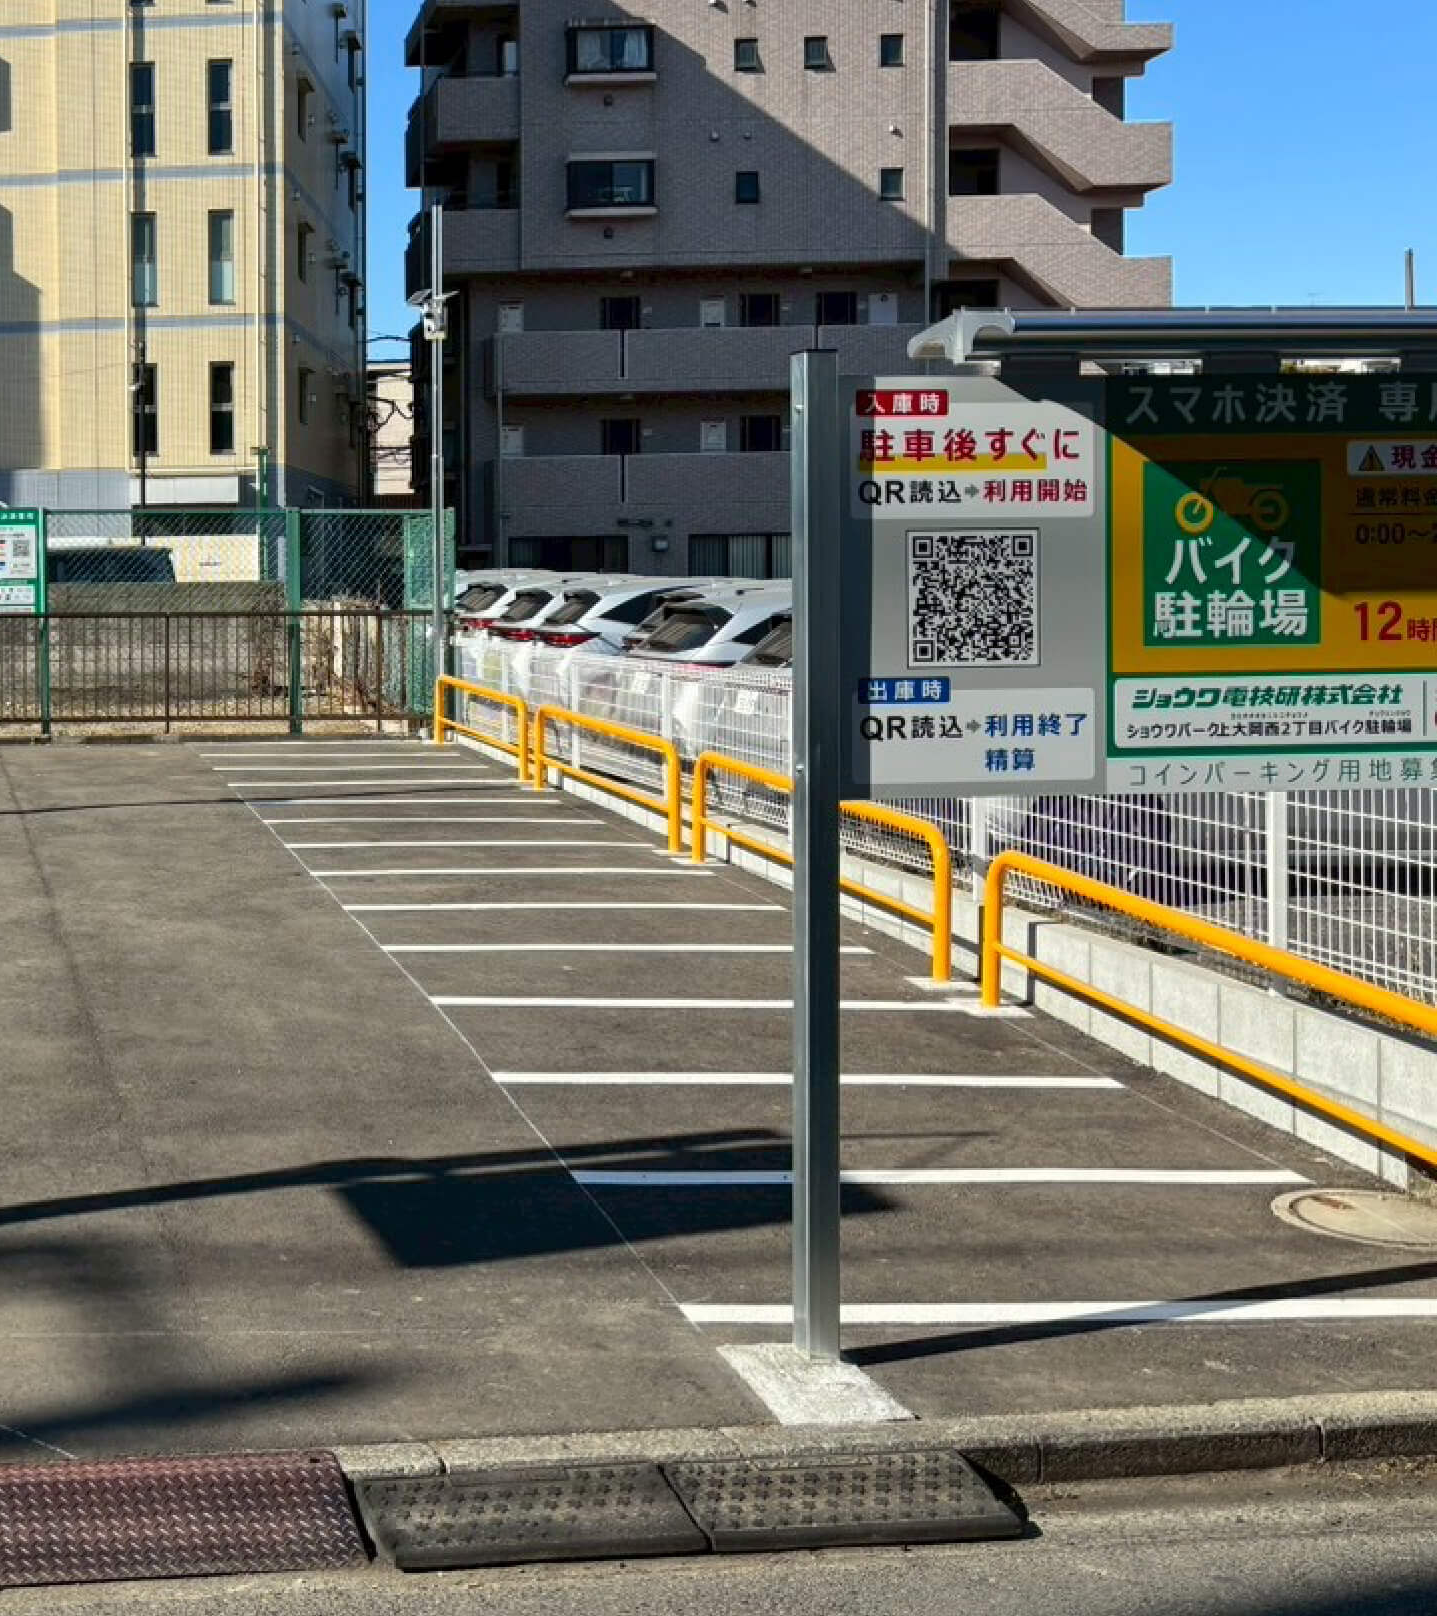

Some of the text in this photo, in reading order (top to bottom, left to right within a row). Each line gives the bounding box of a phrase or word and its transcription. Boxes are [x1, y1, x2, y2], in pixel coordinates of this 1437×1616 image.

[865, 392, 940, 414] 入庫時
[1126, 383, 1348, 423] スマホ決済
[862, 428, 1079, 462] 駐車後すぐに
[859, 478, 1088, 505] QR読込 利用開始
[1165, 536, 1295, 584] バイク
[1153, 589, 1308, 639] 駐輪場
[1354, 601, 1437, 642] 12時
[868, 680, 942, 700] 出庫時
[1132, 684, 1403, 709] ショウワ電技研株式会社
[860, 713, 1087, 742] QR読込 利用終了
[984, 748, 1035, 772] 精算
[1130, 757, 1437, 787] コインパーキング用地募
